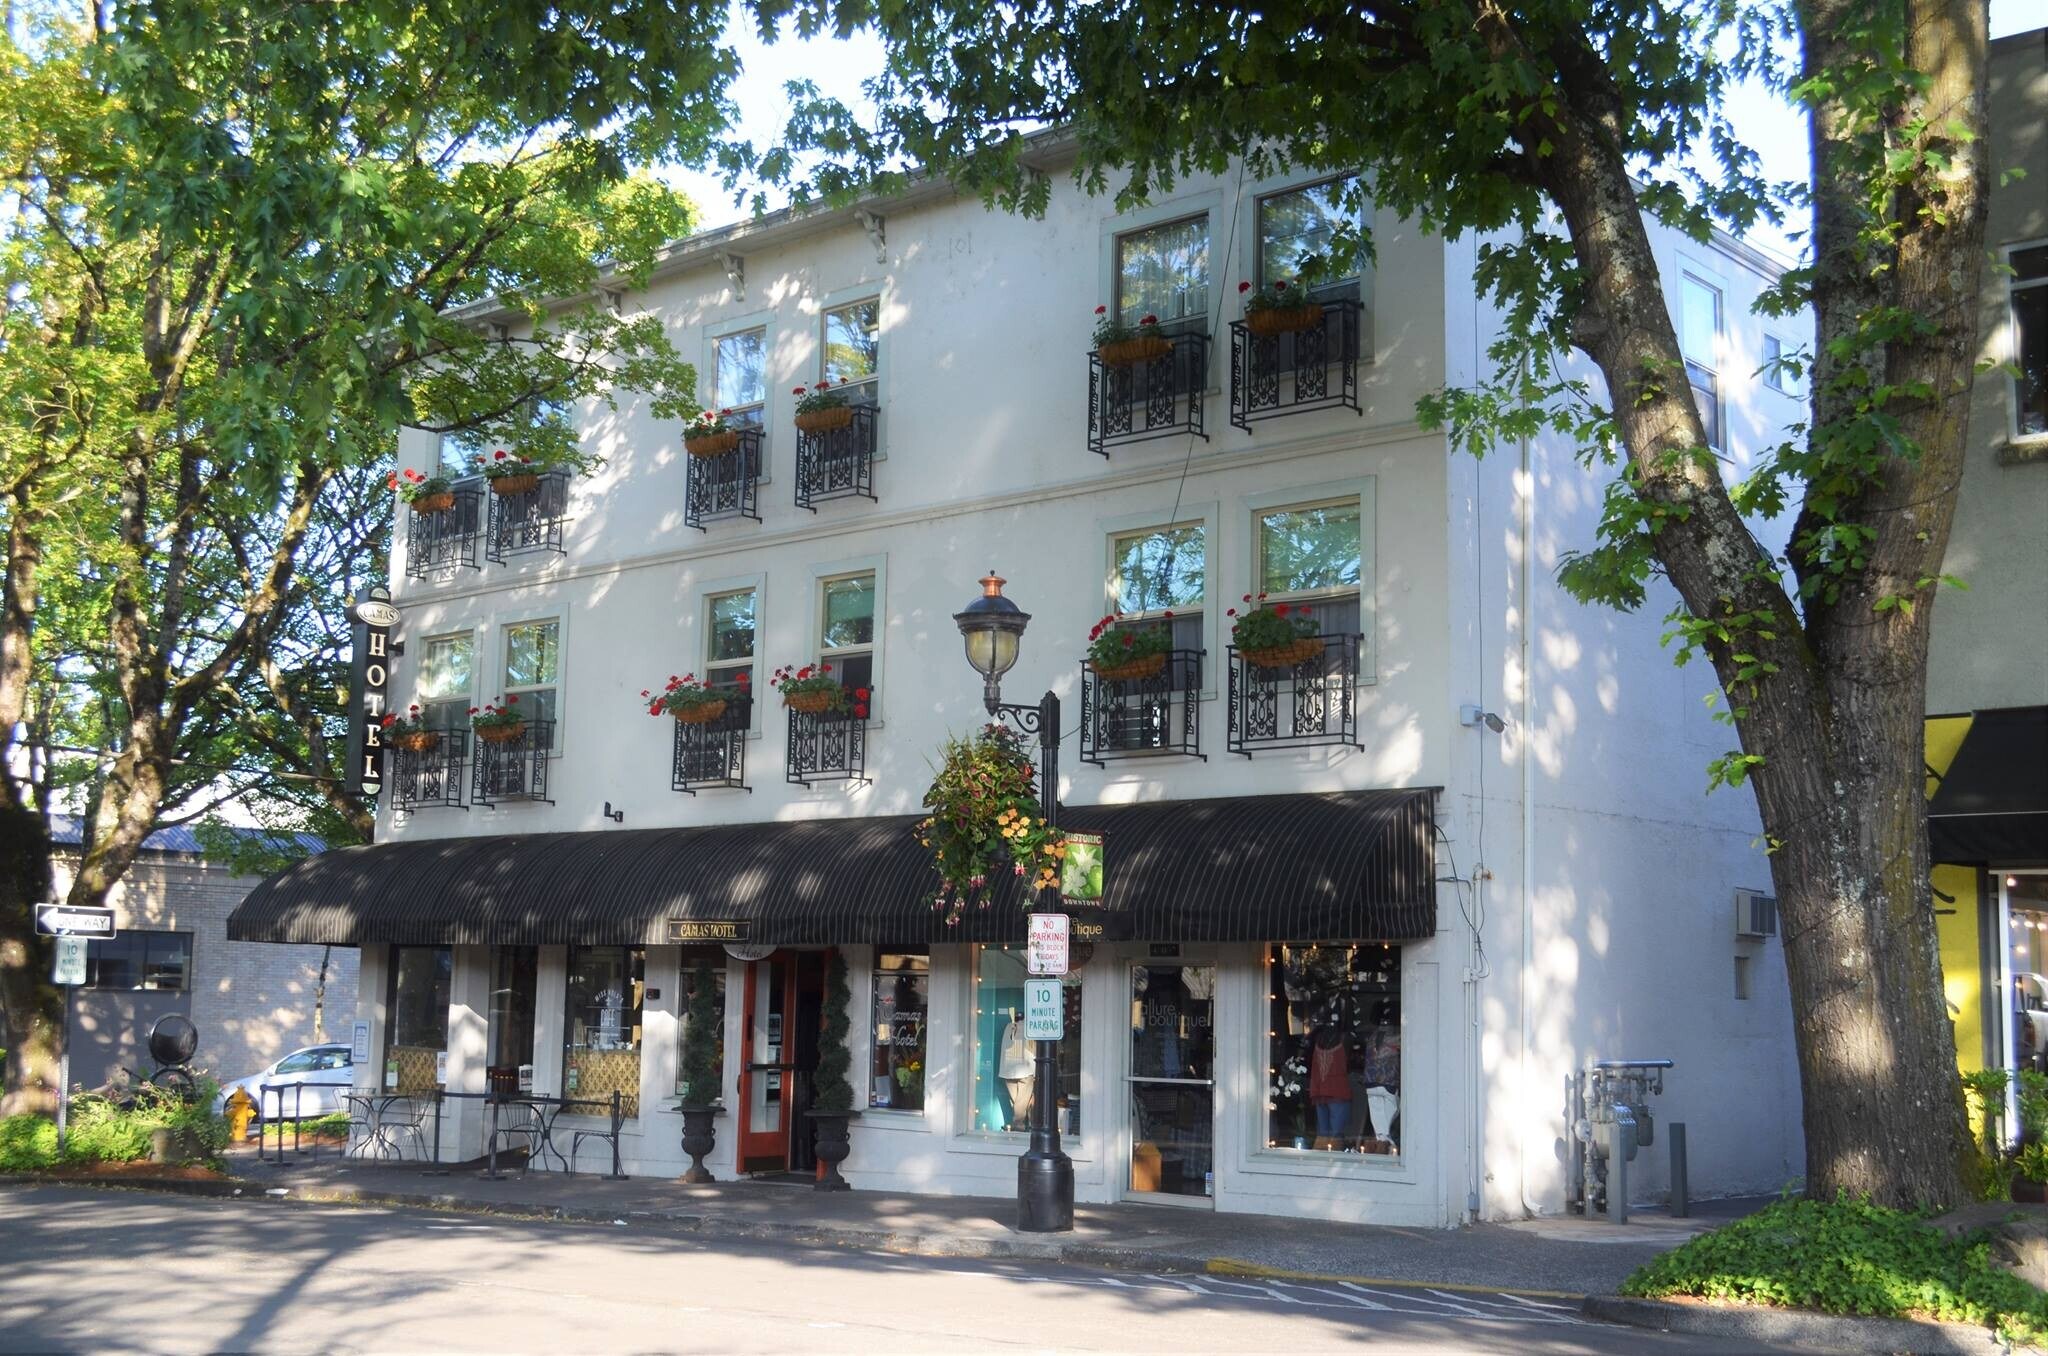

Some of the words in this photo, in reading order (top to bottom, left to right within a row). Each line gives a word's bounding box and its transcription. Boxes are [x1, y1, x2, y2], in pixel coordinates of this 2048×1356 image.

[363, 607, 395, 621] CAMAS
[363, 632, 387, 779] HOTEL
[1065, 832, 1102, 844] HISTORIC
[59, 915, 77, 927] ONE
[84, 917, 107, 928] WAY
[1043, 921, 1054, 929] NO
[680, 924, 709, 936] CAMAS
[711, 925, 737, 937] HOTEL
[1032, 932, 1065, 941] PARKING
[1071, 923, 1103, 938] utique
[67, 945, 78, 955] 10
[1037, 990, 1050, 1003] 10
[1032, 1008, 1056, 1016] MINUTE
[1143, 998, 1176, 1016] allure
[1029, 1020, 1059, 1031] PARKING
[1148, 1011, 1207, 1034] boutique
